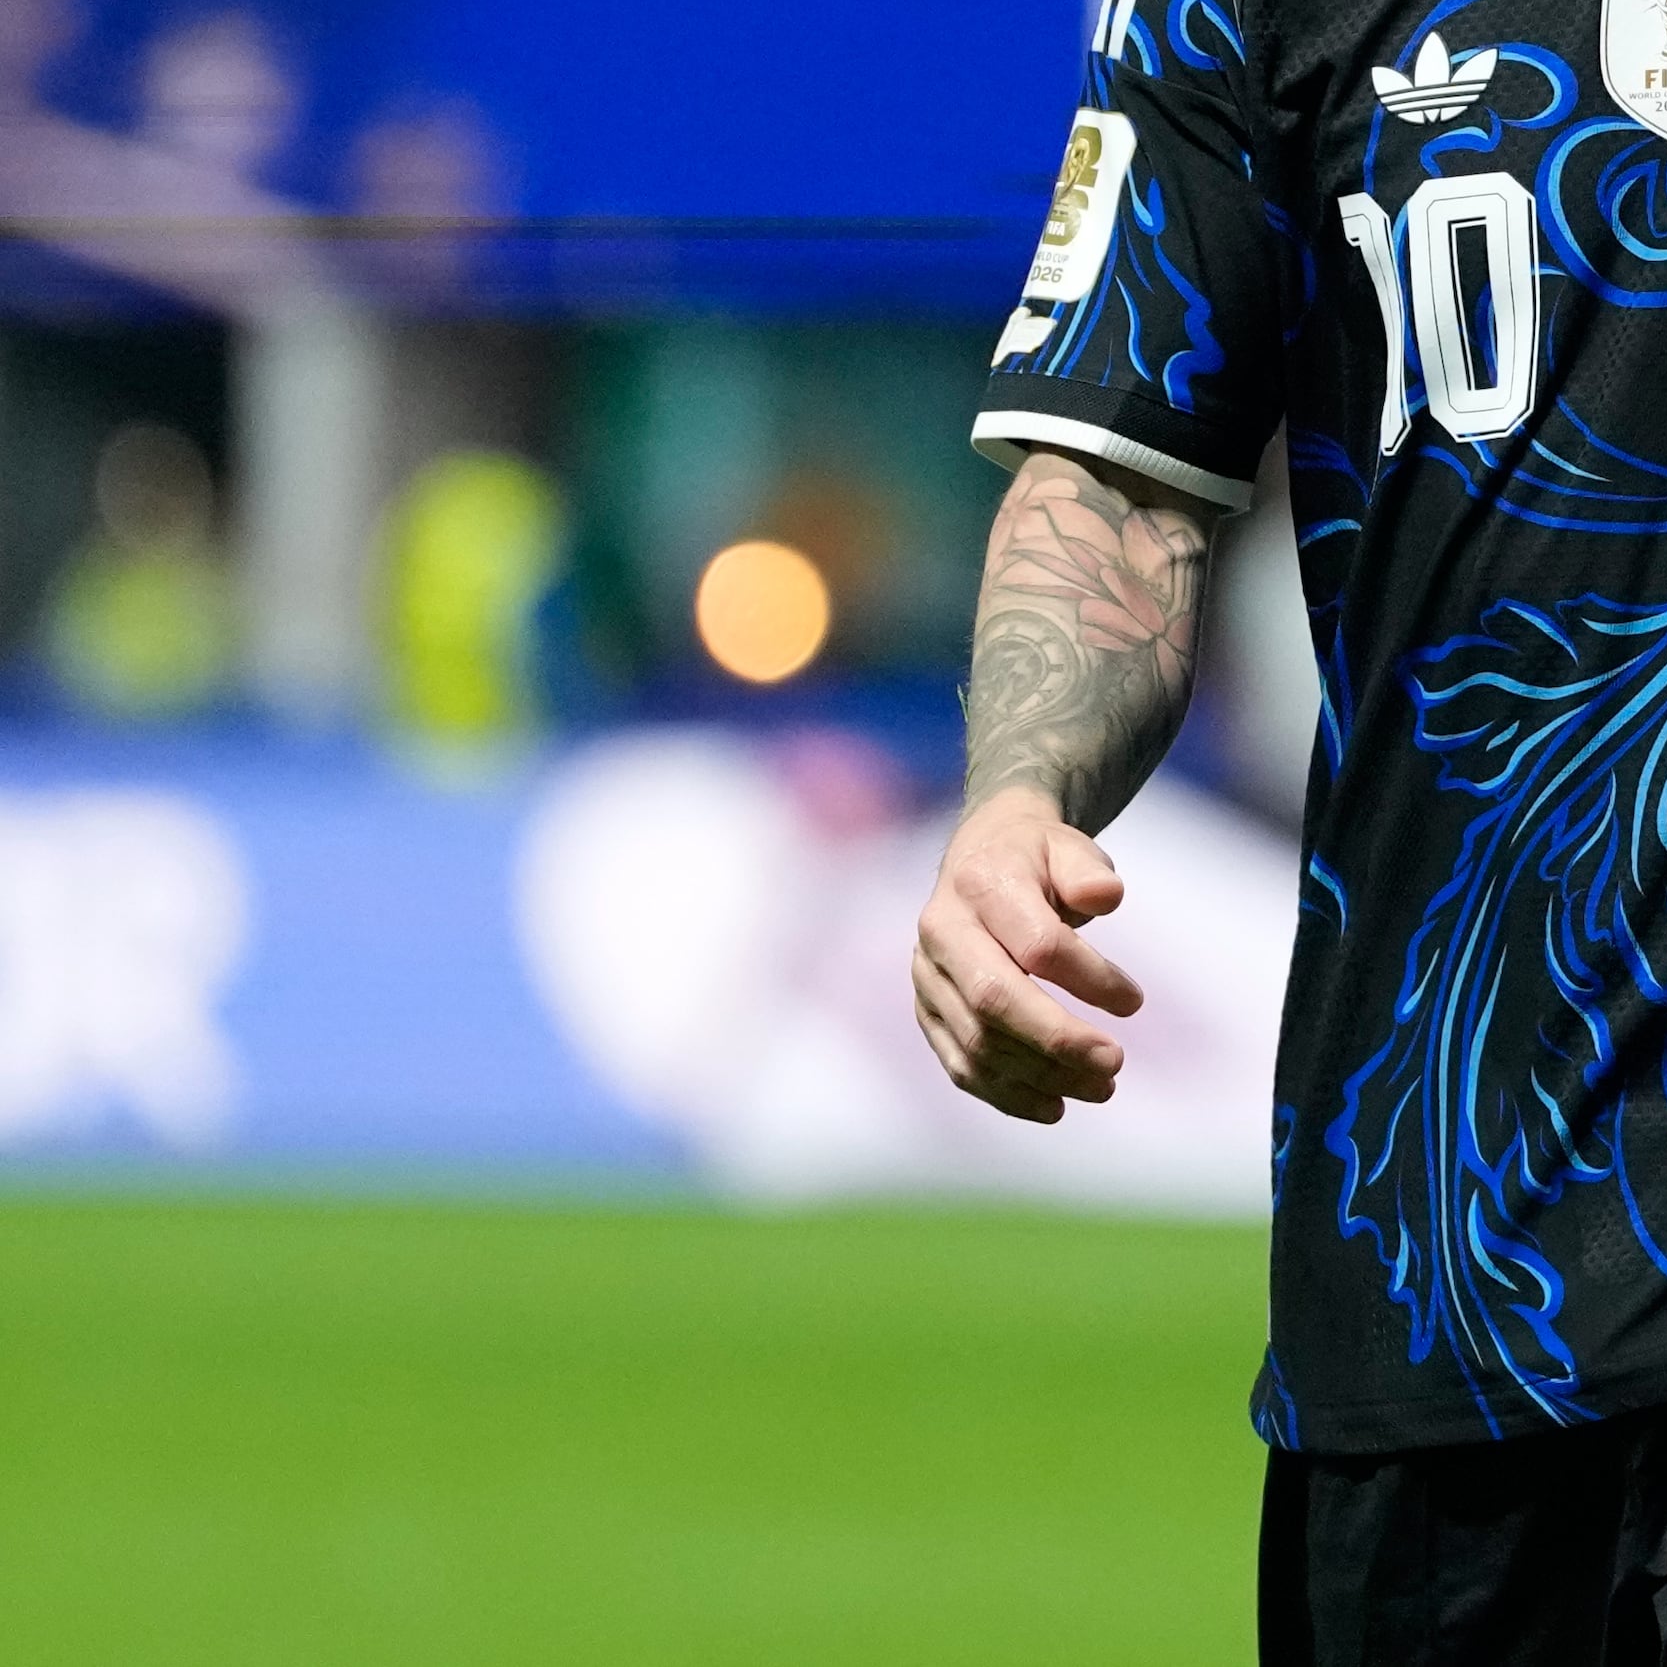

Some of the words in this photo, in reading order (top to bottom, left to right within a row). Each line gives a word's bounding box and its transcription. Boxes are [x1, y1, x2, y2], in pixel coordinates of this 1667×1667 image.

[1629, 91, 1661, 100] WORLD
[1031, 265, 1064, 283] 026
[1337, 172, 1541, 456] 10
